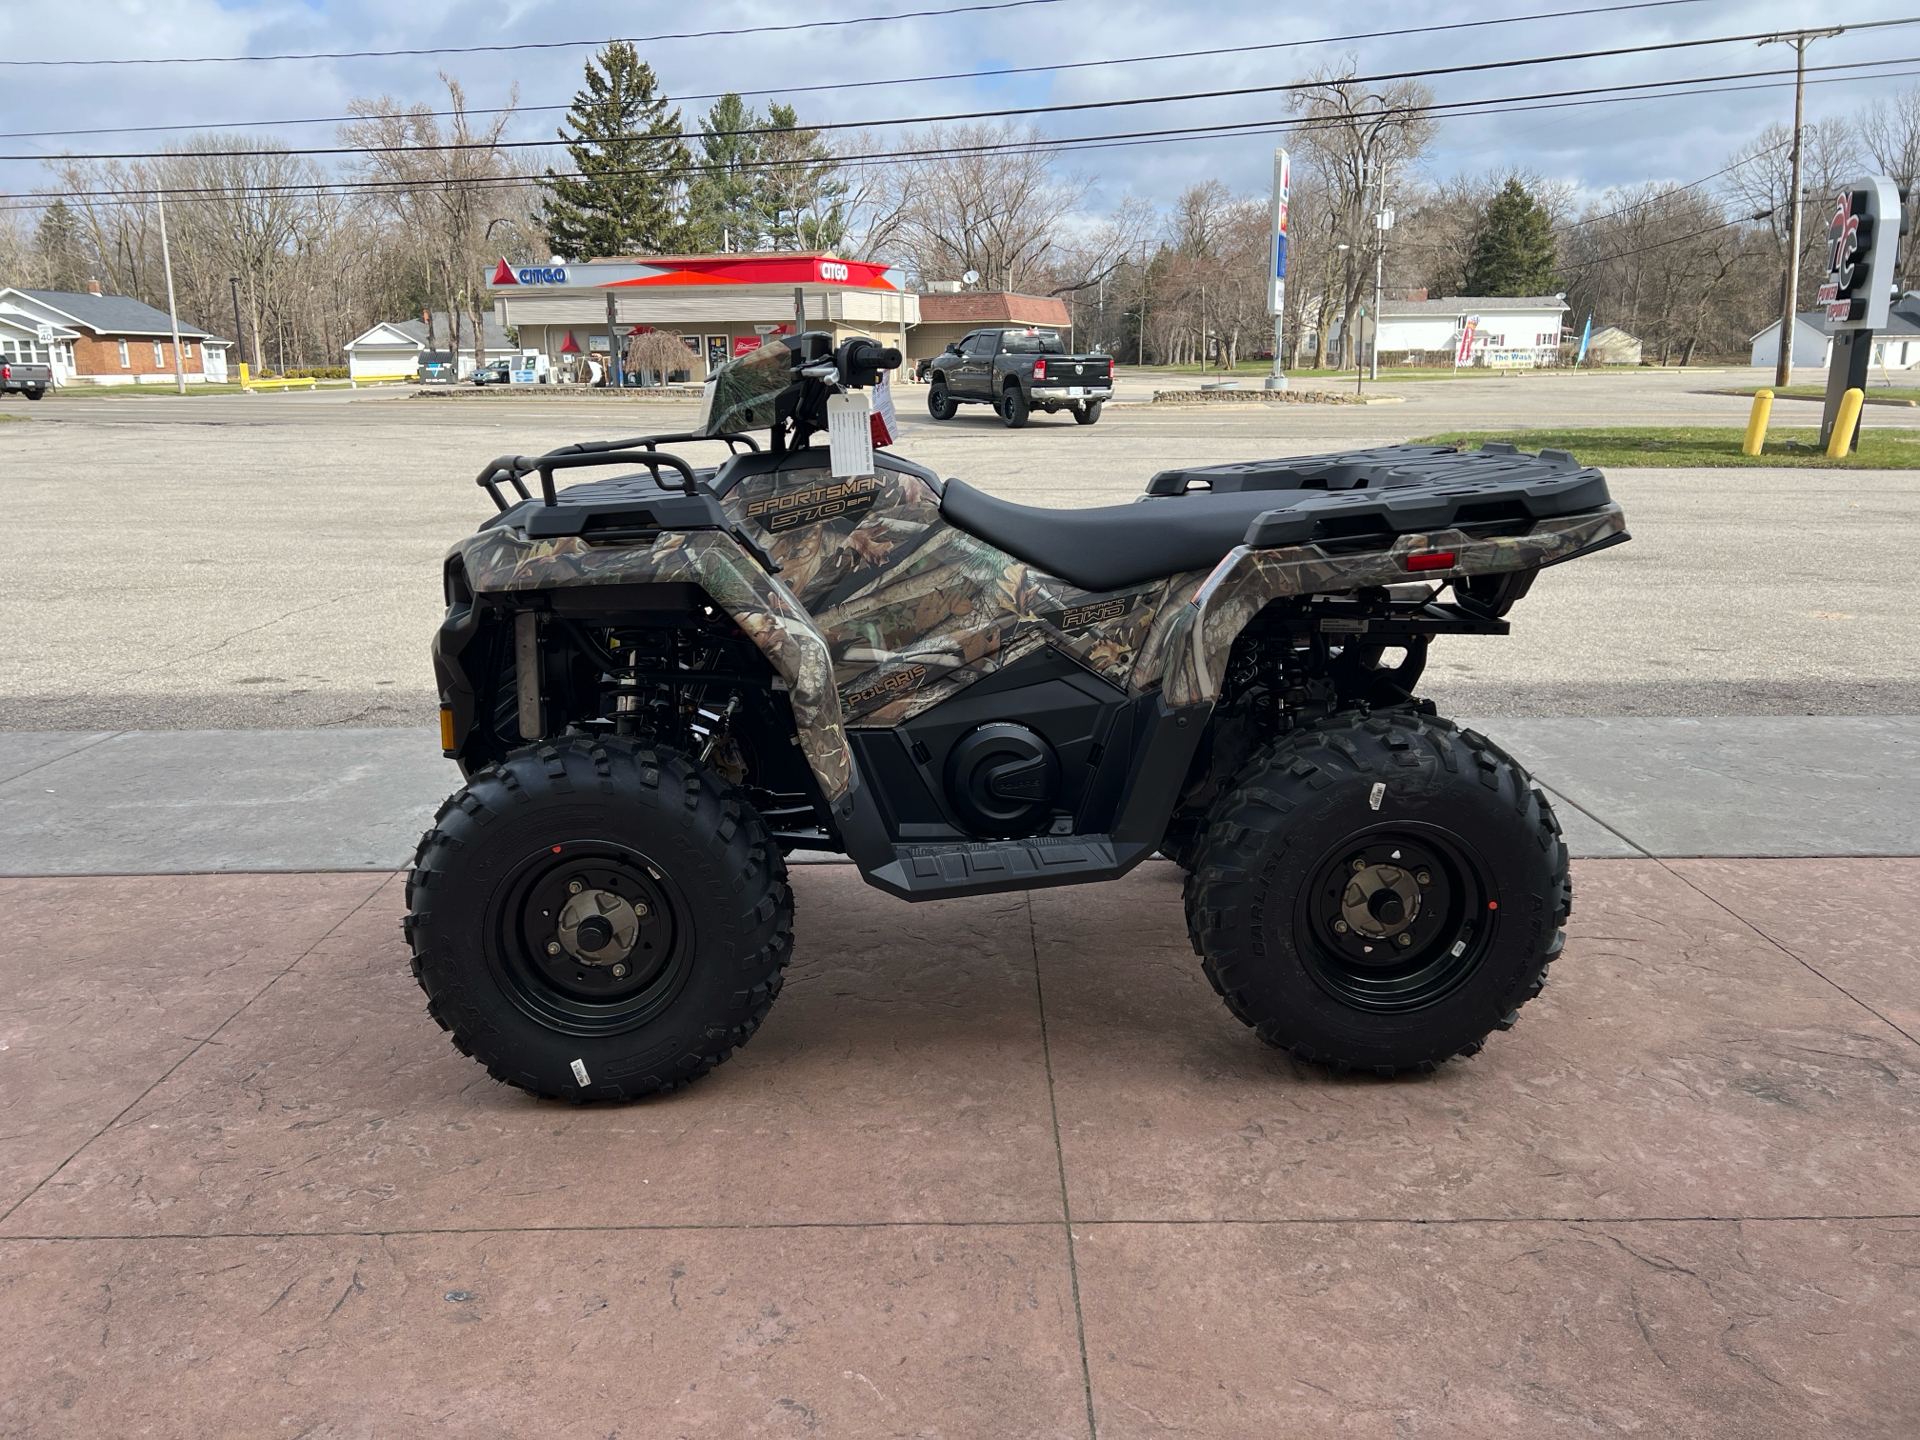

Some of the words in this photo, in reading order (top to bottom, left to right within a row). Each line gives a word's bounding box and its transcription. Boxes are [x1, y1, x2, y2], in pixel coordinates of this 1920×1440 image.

[519, 268, 567, 284] CITGO
[822, 262, 848, 281] CITGO
[1819, 285, 1838, 301] POWER
[1828, 302, 1851, 318] SPORTS
[41, 333, 52, 341] 40
[746, 475, 887, 517] SPORTSMAN
[770, 499, 846, 530] 570
[846, 495, 872, 507] EFI
[1081, 598, 1126, 612] DEMAND
[1062, 604, 1125, 628] AWD
[848, 664, 928, 707] POLARIS
[670, 833, 736, 959] CARLISLE
[1250, 829, 1299, 957] CARLISLE
